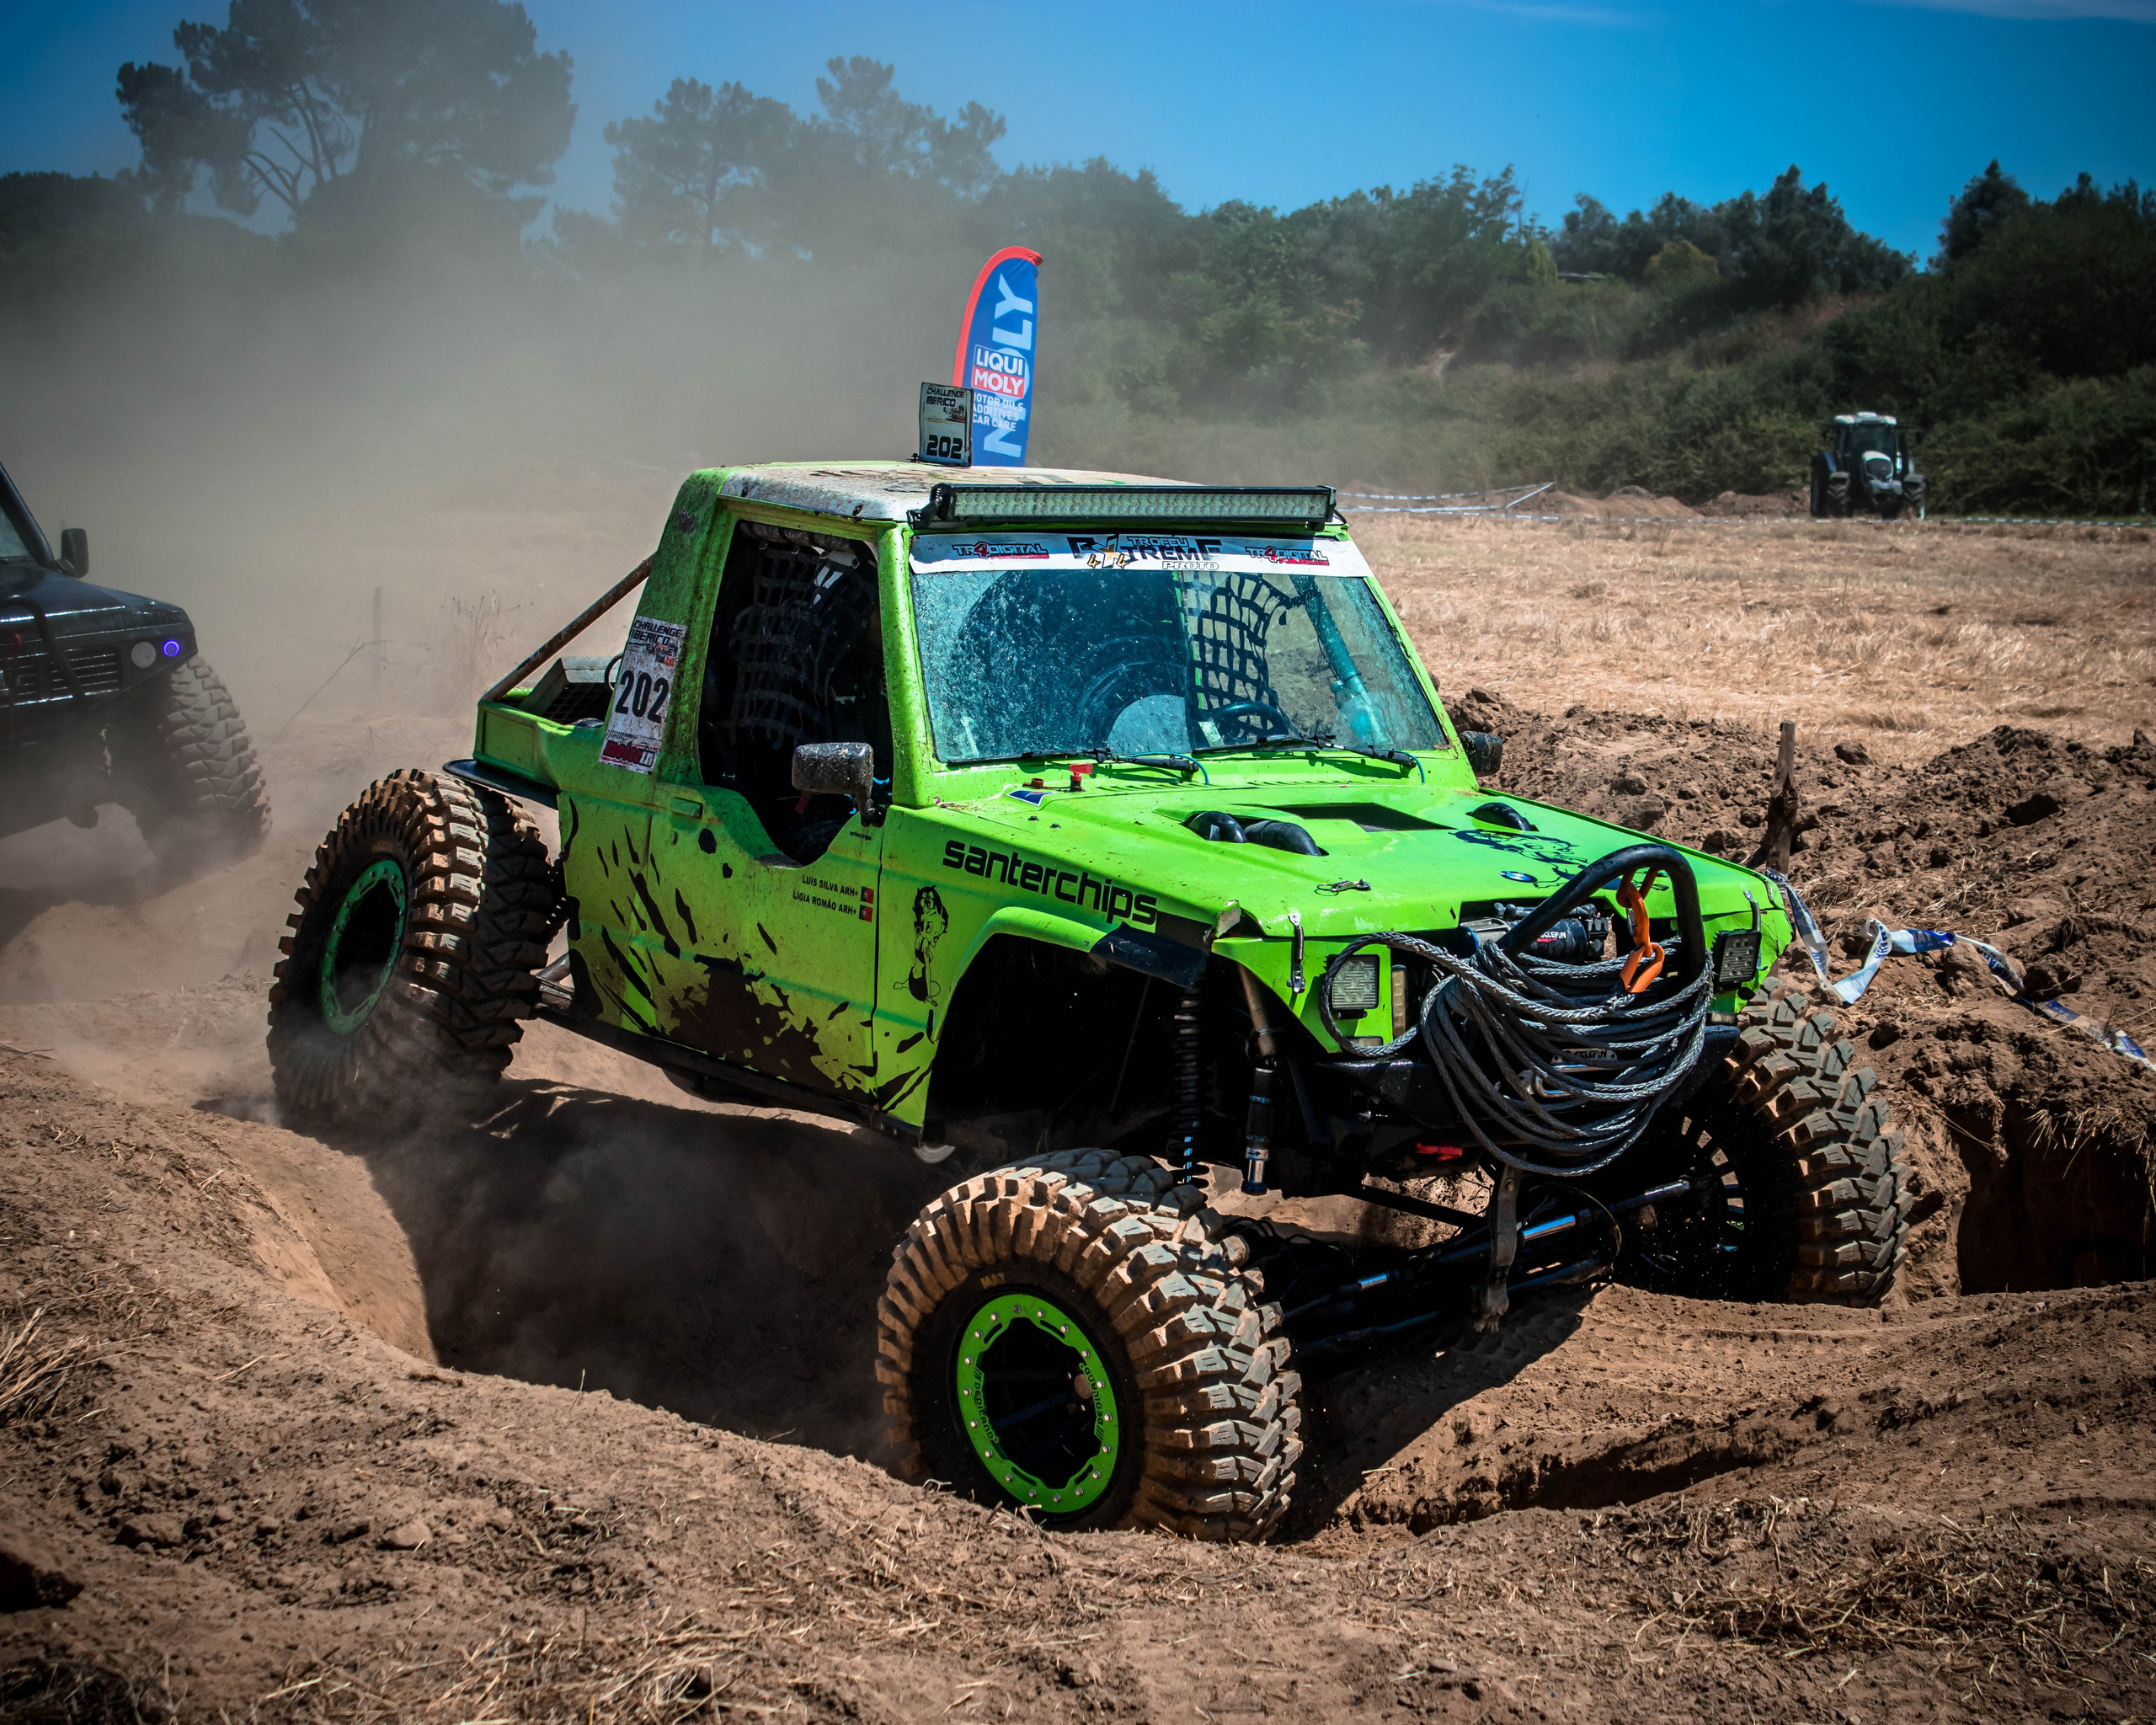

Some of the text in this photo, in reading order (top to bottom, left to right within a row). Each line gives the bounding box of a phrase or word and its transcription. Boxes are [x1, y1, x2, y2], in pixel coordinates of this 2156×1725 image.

[976, 348, 1023, 376] LIQUI
[974, 368, 1024, 395] MOLY
[926, 387, 965, 398] CHALLENGE
[926, 396, 956, 407] IBERICO
[974, 393, 1023, 412] OTOR OILS
[973, 403, 1020, 422] ADDITIVES
[973, 413, 1017, 432] CAR CARE
[926, 434, 963, 460] 202
[1162, 560, 1219, 570] PROTO
[631, 629, 671, 646] IBERICO
[634, 620, 682, 638] CHALLENGE
[615, 670, 669, 724] 202
[819, 879, 838, 893] SILVA
[840, 885, 858, 897] ARH+
[942, 839, 1157, 926] santerchips
[812, 895, 836, 911] ROMÃO
[838, 904, 857, 916] ARH+
